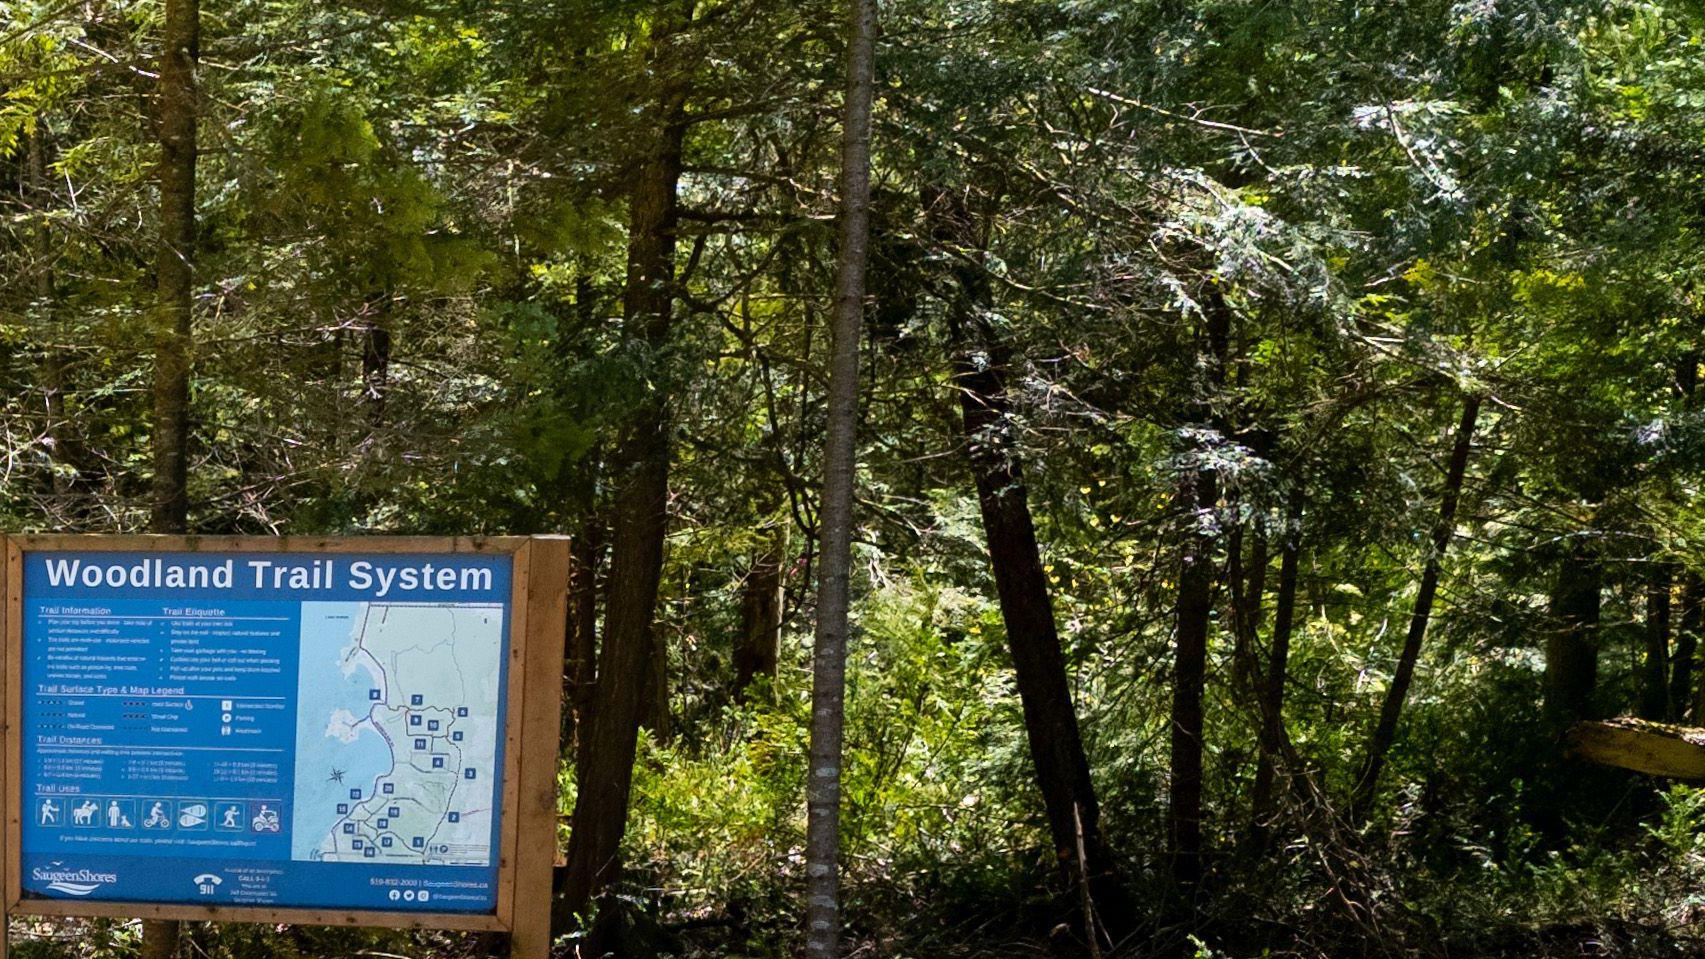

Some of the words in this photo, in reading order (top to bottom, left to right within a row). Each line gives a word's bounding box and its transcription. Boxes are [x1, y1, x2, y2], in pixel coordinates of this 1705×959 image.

[46, 559, 233, 588] Woodland
[249, 560, 333, 589] Trail
[349, 562, 493, 597] System
[40, 606, 59, 614] Trail
[62, 606, 112, 615] Information
[162, 607, 183, 615] Trail
[185, 608, 226, 617] Etiquette
[38, 685, 58, 693] Trail
[61, 685, 94, 693] Surface
[96, 685, 118, 695] Type
[120, 686, 128, 694] &
[129, 686, 149, 695] Map
[151, 687, 184, 696] Legend
[37, 735, 57, 744] Trail
[59, 736, 102, 745] Distances
[36, 783, 56, 792] Trail
[58, 784, 80, 792] Uses
[33, 868, 117, 883] SaugeenShores
[200, 884, 214, 895] 911
